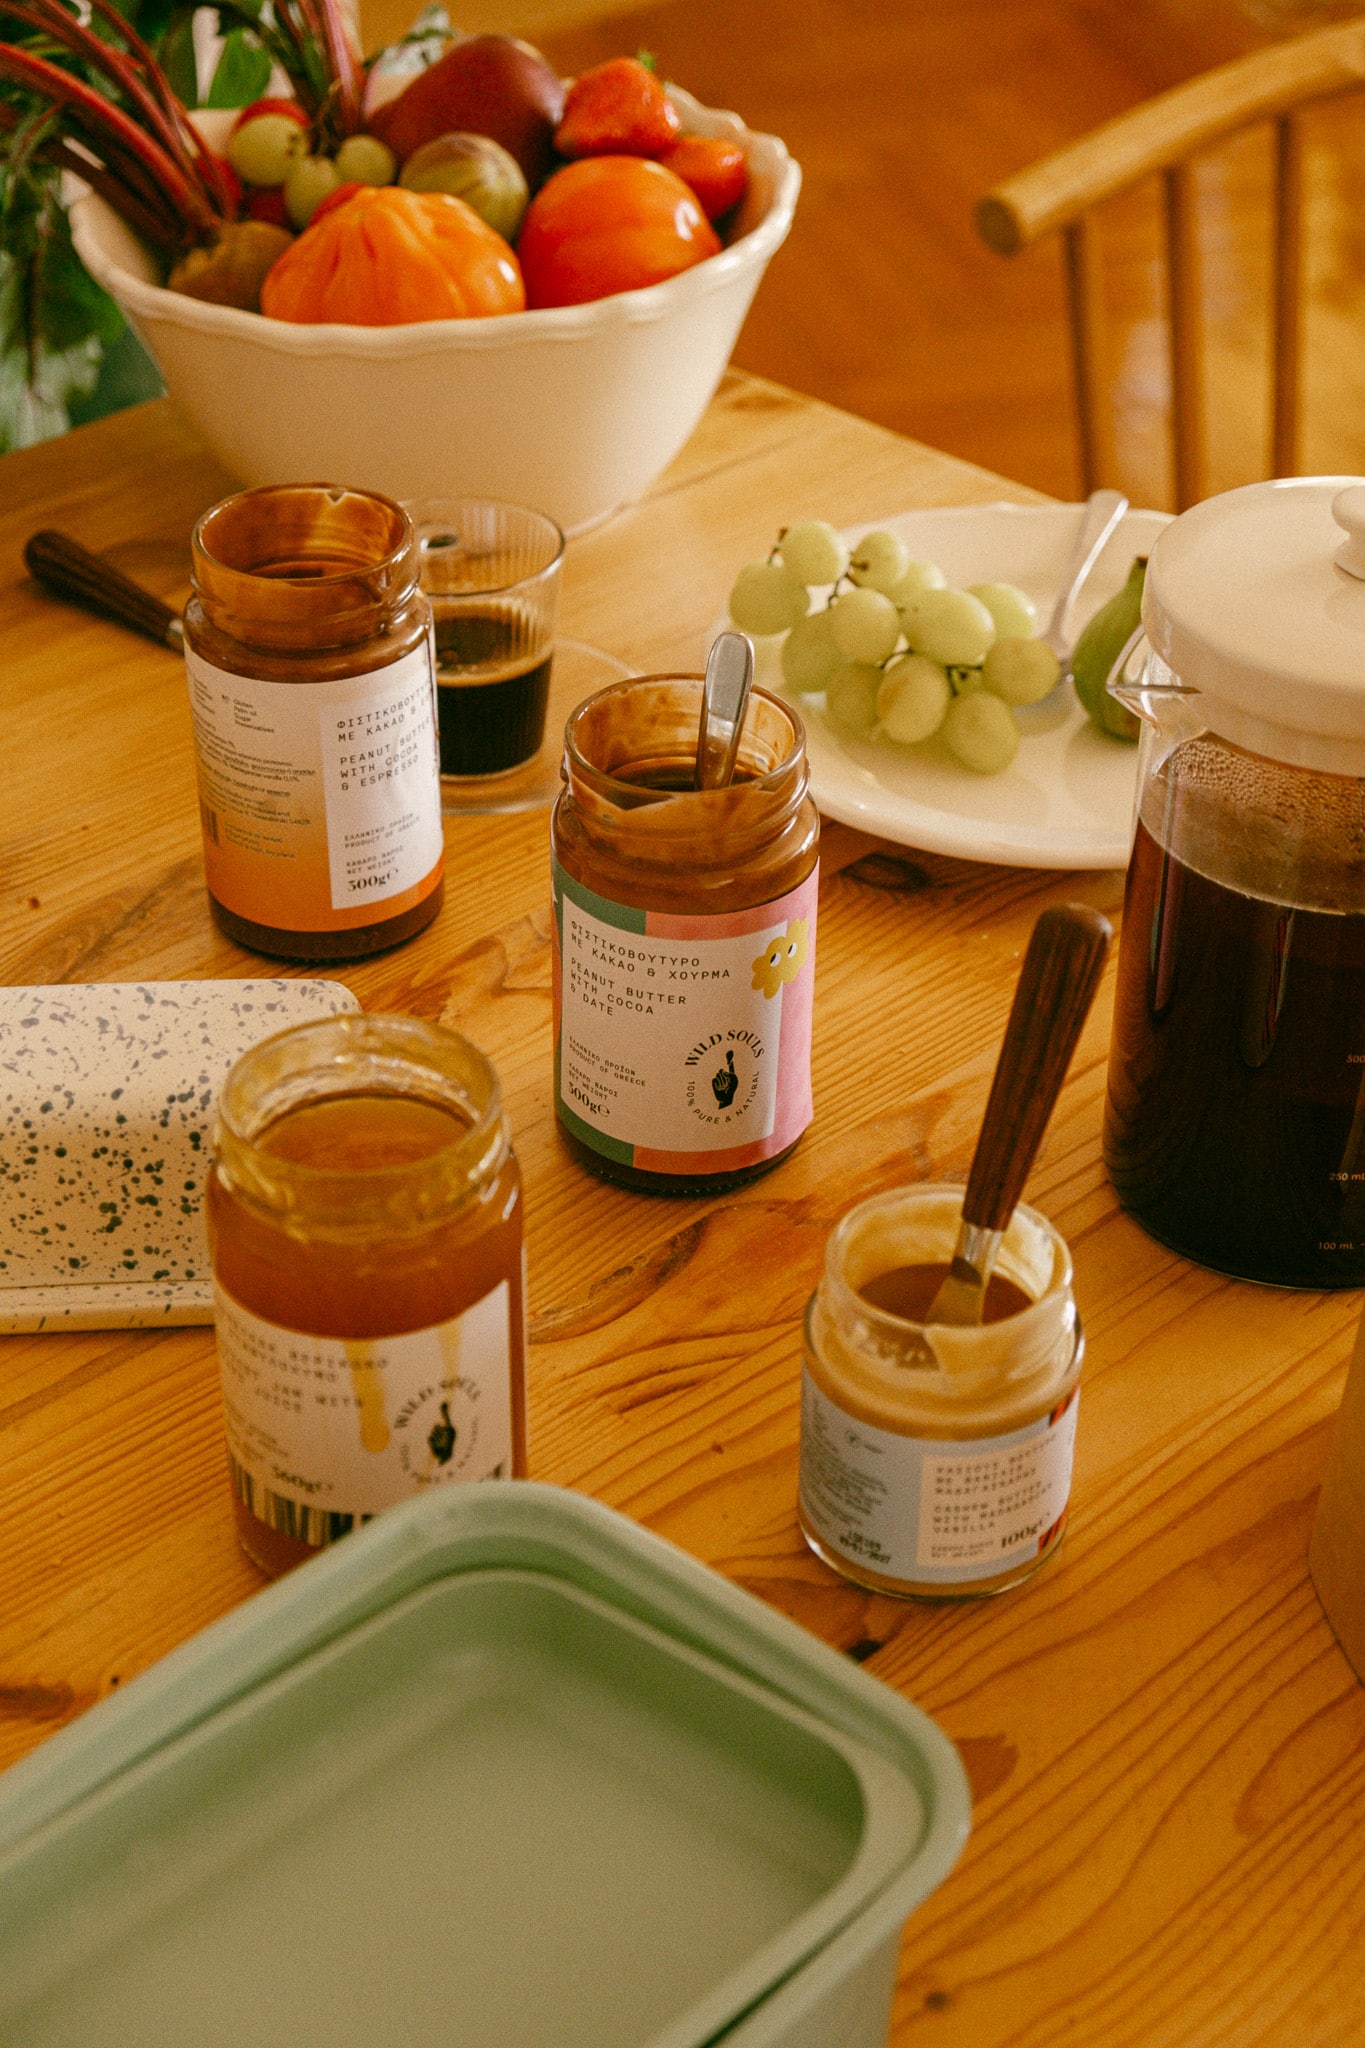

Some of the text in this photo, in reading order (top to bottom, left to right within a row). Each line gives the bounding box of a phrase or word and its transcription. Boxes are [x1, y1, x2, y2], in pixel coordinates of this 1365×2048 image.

[366, 714, 405, 736] ΚΑΚΑΟ
[340, 744, 391, 766] PEANUT
[340, 743, 417, 779] WITH COCOA
[341, 754, 418, 791] & ESPRESSO
[571, 920, 700, 967] ΦΙΣΤΙΚΟΒΟΥΤΥΡΟ
[571, 957, 687, 1005] PEANUT BUTTER
[592, 948, 636, 973] ΚΑΚΑΟ
[647, 968, 656, 977] &
[669, 969, 730, 980] ΧΟΥΡΜΑ
[571, 970, 654, 1015] WITH COCOA
[583, 993, 614, 1016] DATE
[569, 1043, 646, 1087] PRODUCT OF GREECE
[684, 1029, 765, 1066] WILD SOULS
[582, 1082, 608, 1101] WEIGHT
[686, 1081, 696, 1107] 100%
[693, 1108, 720, 1124] PURE
[735, 1071, 760, 1116] NATURAL
[1318, 1242, 1336, 1250] 100
